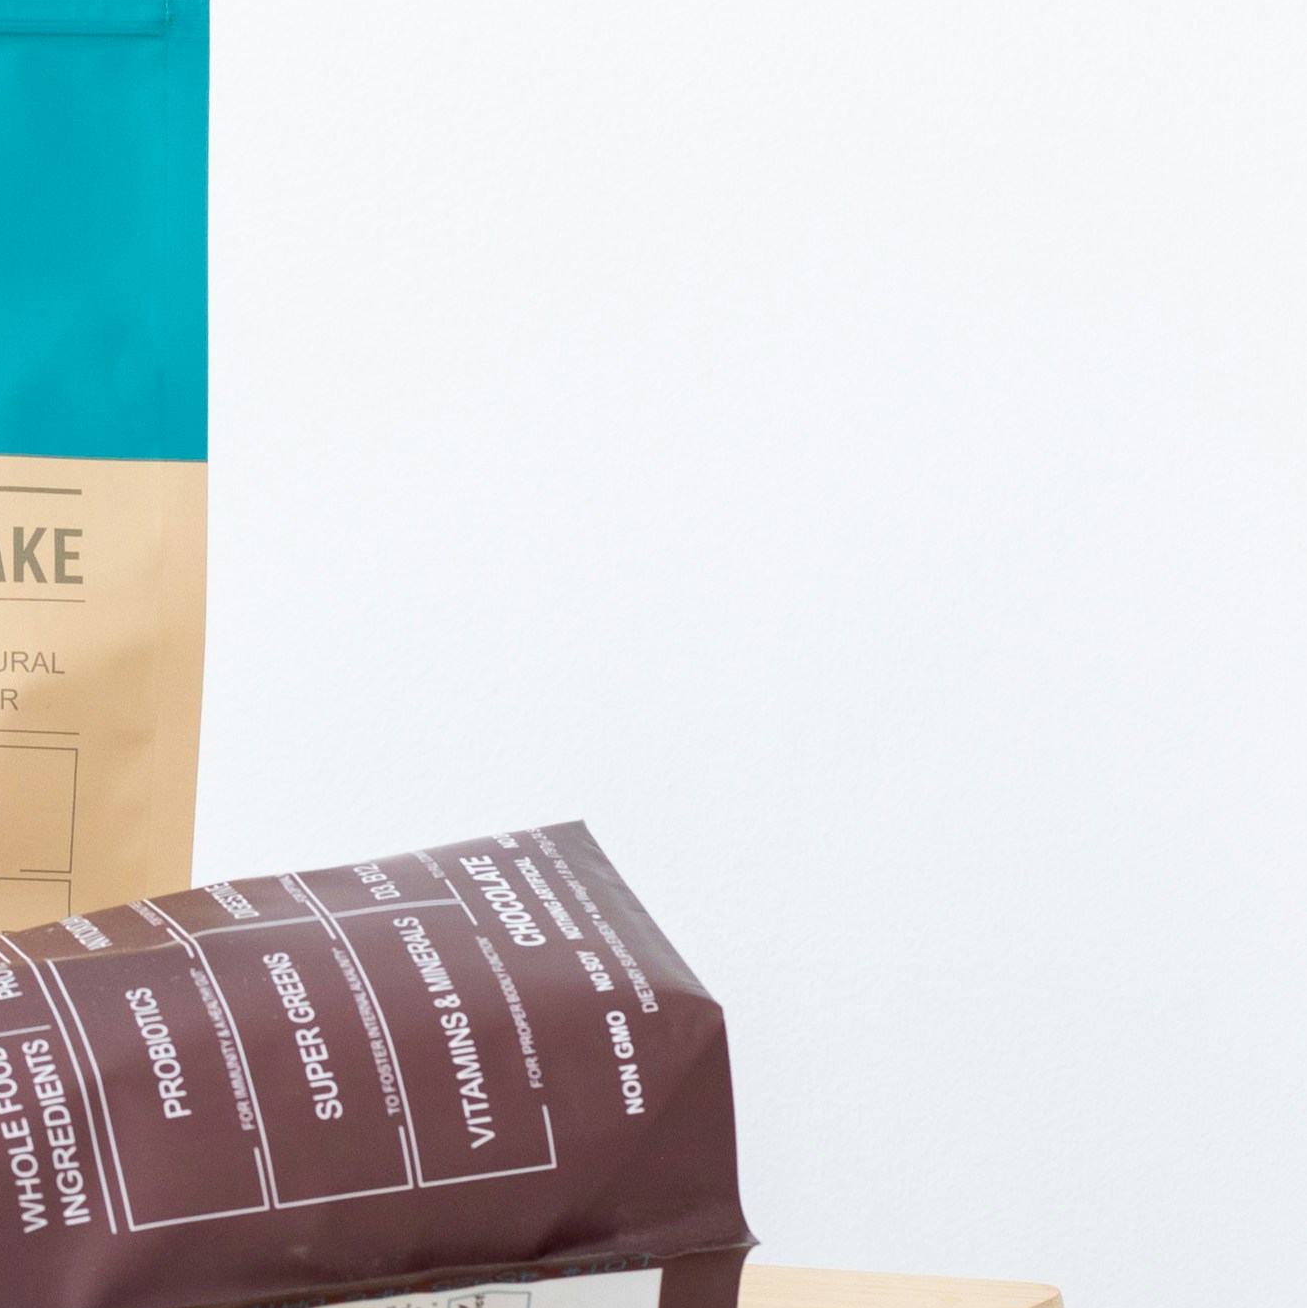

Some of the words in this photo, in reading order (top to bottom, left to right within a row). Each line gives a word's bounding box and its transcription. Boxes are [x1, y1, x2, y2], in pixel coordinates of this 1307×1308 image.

[459, 854, 547, 947] CHOCOLATE
[514, 856, 557, 901] ARTIFICIAL
[543, 901, 584, 940] NOTHING
[592, 919, 637, 969] SUPPLEMENT
[391, 916, 454, 993] MINERALS
[575, 950, 604, 972] SOY
[261, 951, 316, 1024] GREENS
[433, 994, 462, 1010] &
[590, 972, 615, 992] NO
[626, 968, 659, 1014] DIETARY
[125, 987, 192, 1119] PROBIOTICS
[509, 1003, 536, 1055] PROPER
[606, 1009, 636, 1061] GMO
[293, 1024, 344, 1121] SUPER
[370, 1039, 396, 1093] FOSTER
[439, 1011, 495, 1149] VITAMINS
[525, 1056, 544, 1088] FOR
[618, 1063, 646, 1116] NON
[237, 1100, 255, 1130] FOR
[385, 1095, 401, 1116] TO
[21, 1039, 91, 1226] INGREDIENTS
[0, 1117, 49, 1234] WHOLE
